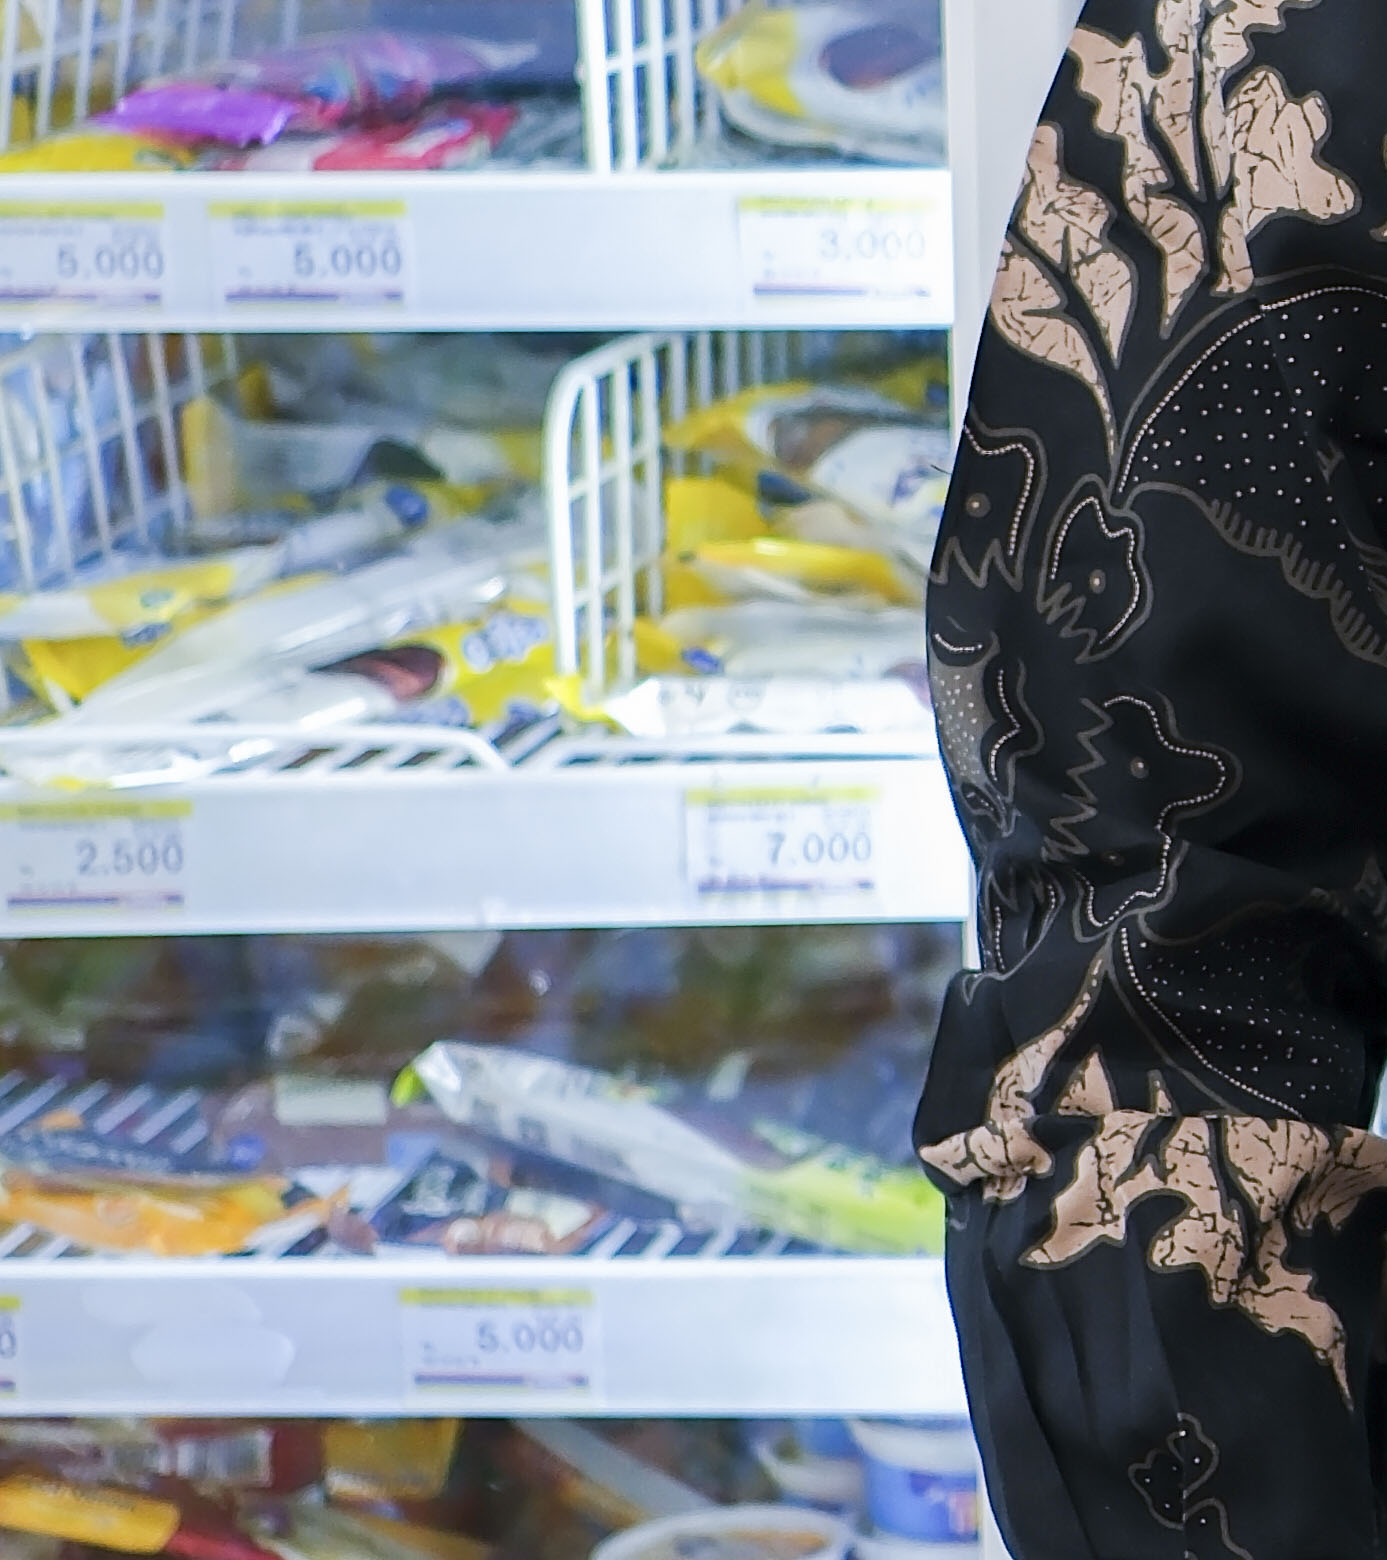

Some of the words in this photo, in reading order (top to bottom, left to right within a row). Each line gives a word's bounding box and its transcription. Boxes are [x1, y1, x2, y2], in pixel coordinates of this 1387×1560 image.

[56, 241, 165, 279] 5.000
[292, 241, 402, 279] 5.000
[818, 228, 926, 262] 3.000
[76, 837, 184, 876] 2.500
[766, 831, 872, 865] 7.000
[475, 1318, 585, 1354] 5.000
